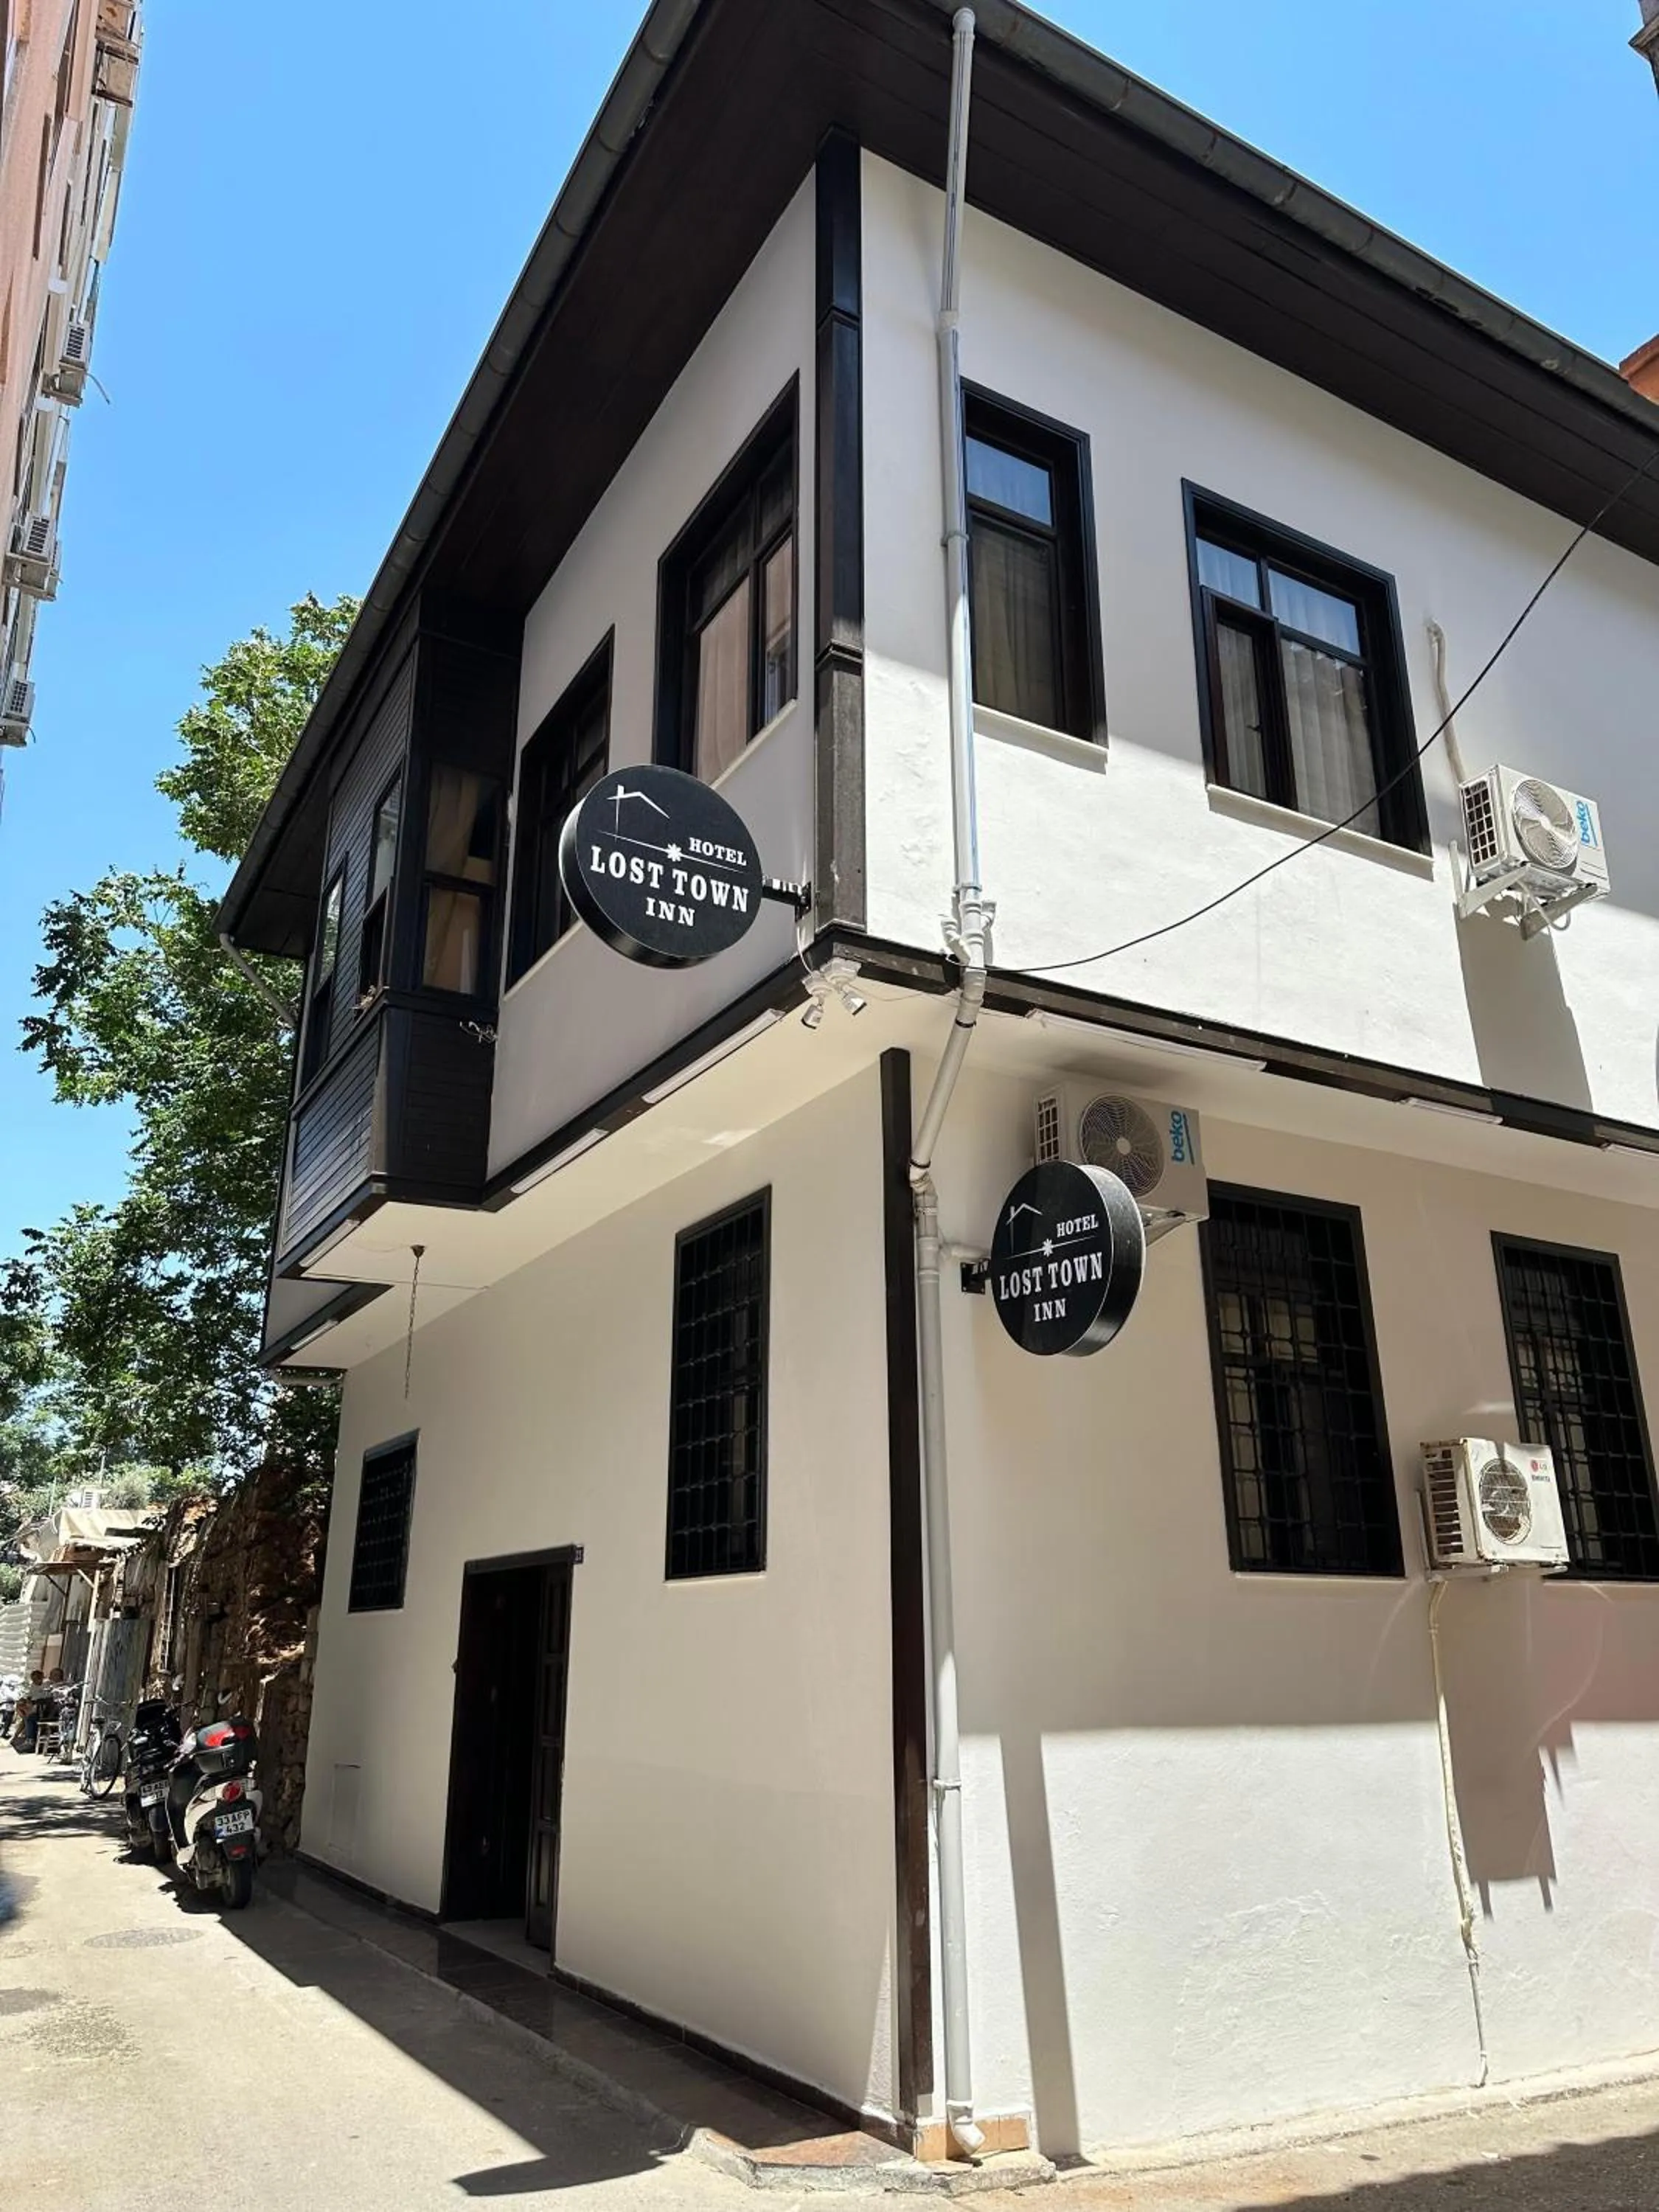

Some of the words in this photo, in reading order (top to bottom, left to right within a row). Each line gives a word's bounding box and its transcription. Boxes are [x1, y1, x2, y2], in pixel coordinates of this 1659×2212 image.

[1576, 800, 1590, 844] beko
[689, 837, 747, 866] HOTEL
[590, 845, 663, 888] LOST
[672, 869, 749, 913] TOWN
[645, 897, 695, 927] INN
[1169, 1110, 1185, 1162] beko
[1057, 1214, 1099, 1238] HOTEL
[999, 1266, 1043, 1301] LOST
[1048, 1252, 1103, 1290] TOWN
[1033, 1298, 1067, 1322] INN
[217, 1816, 230, 1826] 33
